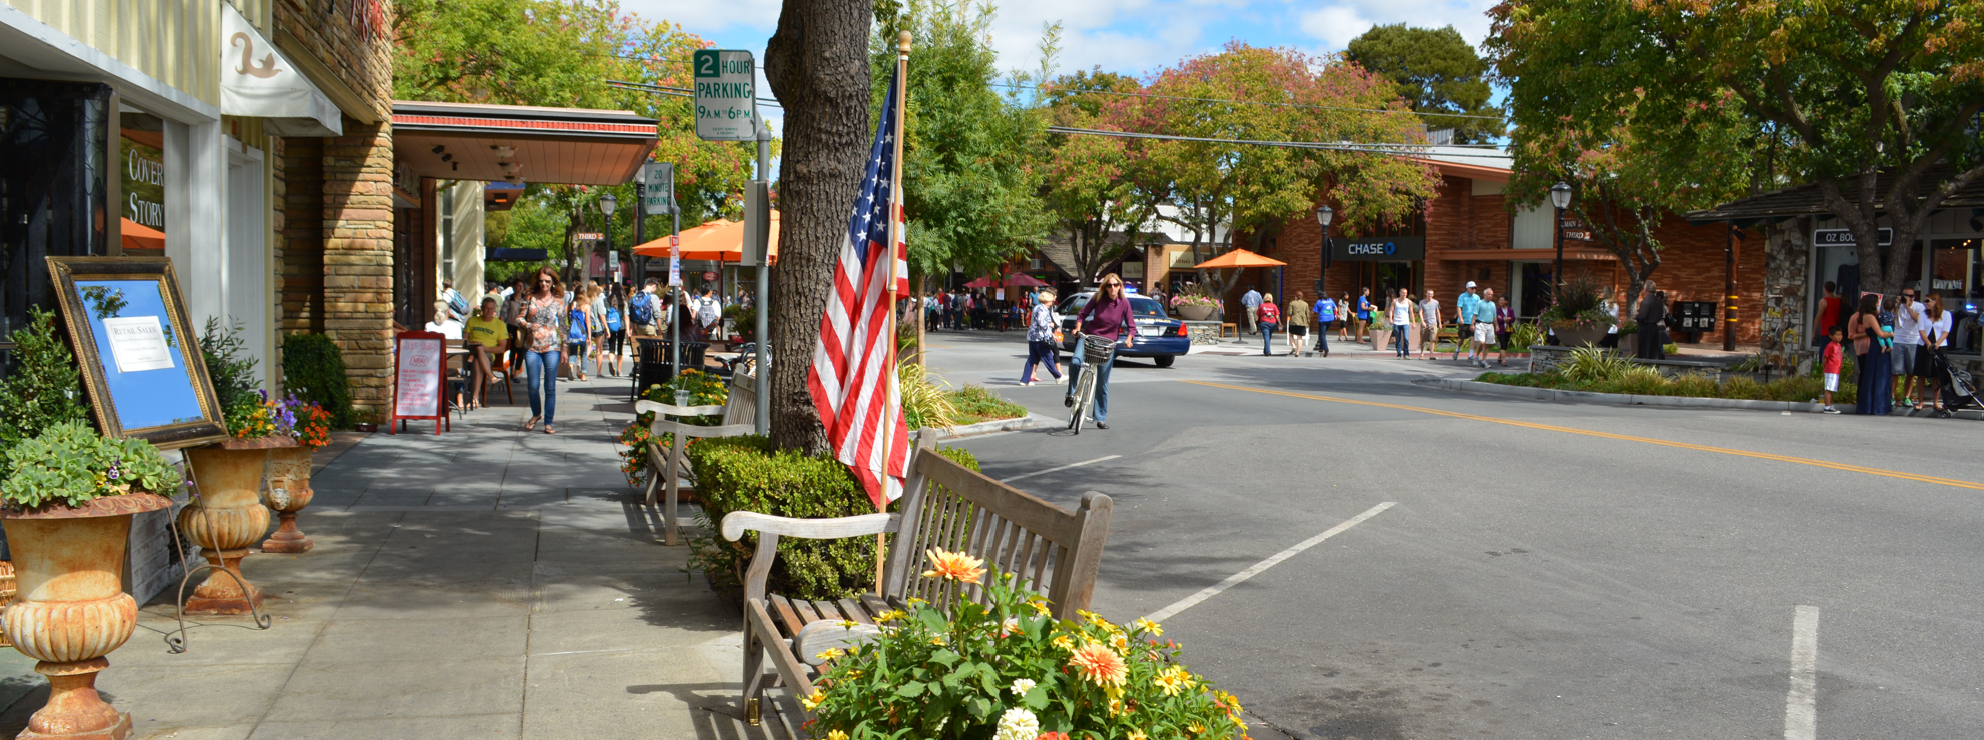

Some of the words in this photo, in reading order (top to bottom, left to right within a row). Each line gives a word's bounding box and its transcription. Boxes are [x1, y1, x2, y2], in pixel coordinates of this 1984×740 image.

[700, 54, 713, 74] 2
[721, 60, 750, 74] HOUR
[697, 82, 751, 99] PARKING
[129, 149, 164, 187] COVER
[654, 169, 663, 180] 20
[648, 183, 669, 193] MINUTE
[646, 196, 671, 207] PARKING
[130, 192, 164, 227] STORY
[1565, 231, 1584, 239] THIRD
[1826, 233, 1837, 242] OZ
[1348, 243, 1384, 255] CHASE
[113, 327, 136, 336] RETAIL
[136, 326, 157, 334] SALES
